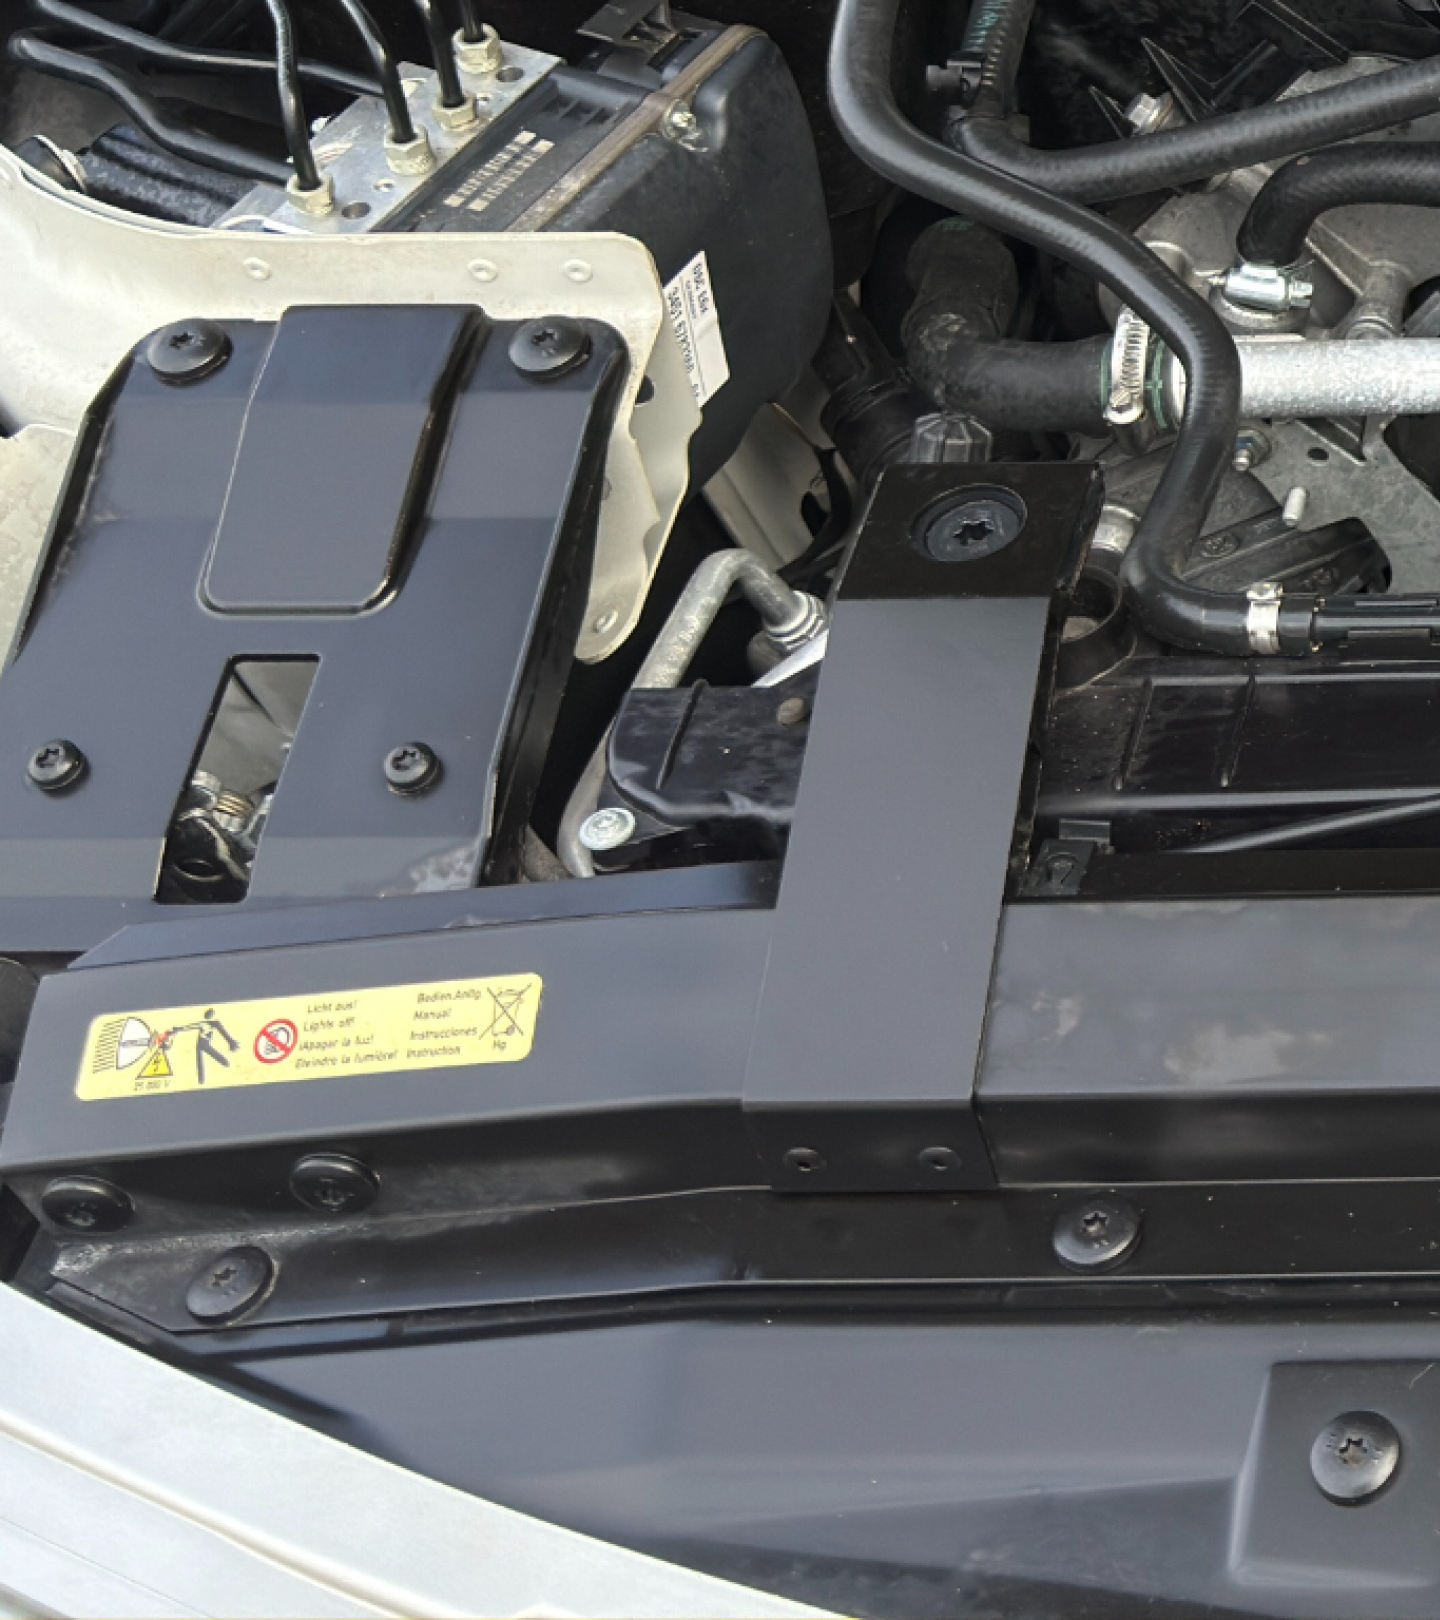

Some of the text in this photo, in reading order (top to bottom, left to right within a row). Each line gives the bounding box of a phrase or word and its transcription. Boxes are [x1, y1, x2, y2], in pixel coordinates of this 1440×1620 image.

[307, 1003, 332, 1014] Licht
[413, 1008, 452, 1021] Manual
[304, 1020, 333, 1033] Lights
[409, 1027, 477, 1040] Instrucciones
[406, 1046, 461, 1058] Instruction
[492, 1040, 506, 1052] Hg
